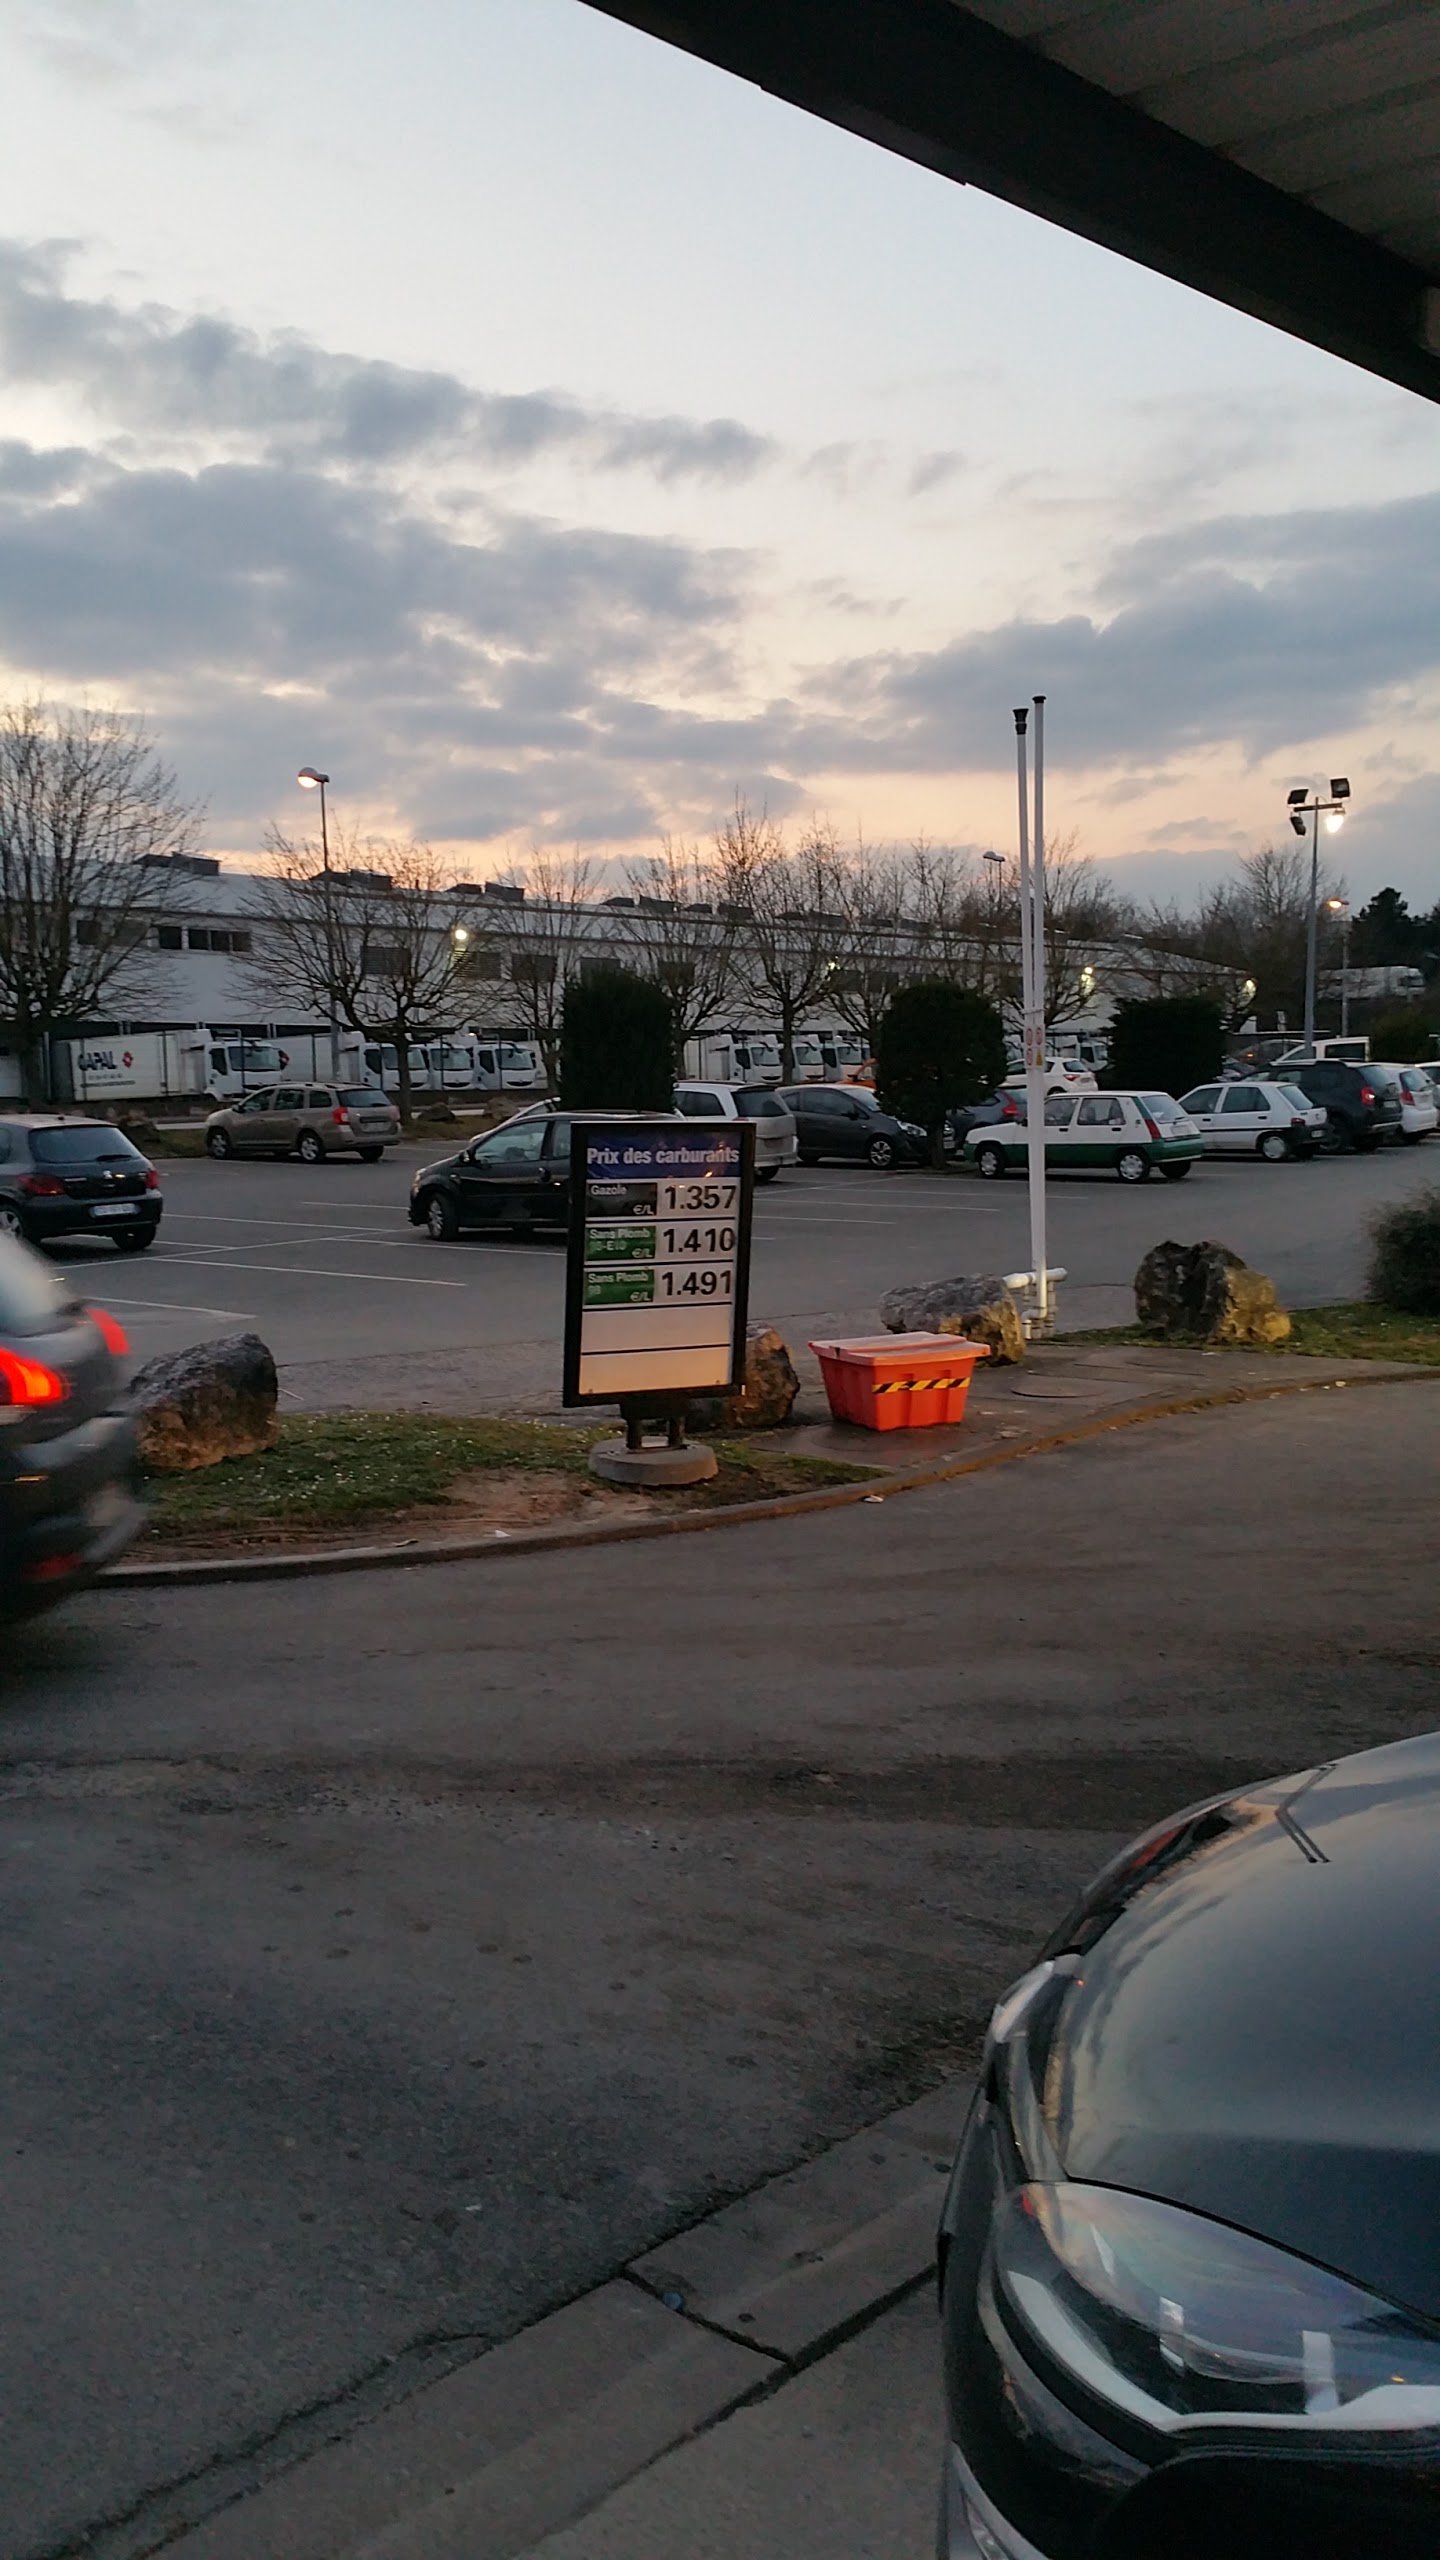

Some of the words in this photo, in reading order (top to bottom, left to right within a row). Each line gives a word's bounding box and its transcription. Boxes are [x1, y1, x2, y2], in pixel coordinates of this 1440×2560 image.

[587, 1148, 619, 1165] Prix
[623, 1148, 652, 1165] des
[656, 1146, 740, 1164] carburants
[665, 1185, 736, 1210] 1.357
[590, 1229, 615, 1239] Sans
[618, 1228, 650, 1238] Plomb
[663, 1228, 735, 1253] 1.410
[588, 1273, 614, 1283] Sans
[617, 1272, 648, 1282] Plomb
[662, 1270, 732, 1296] 1.491
